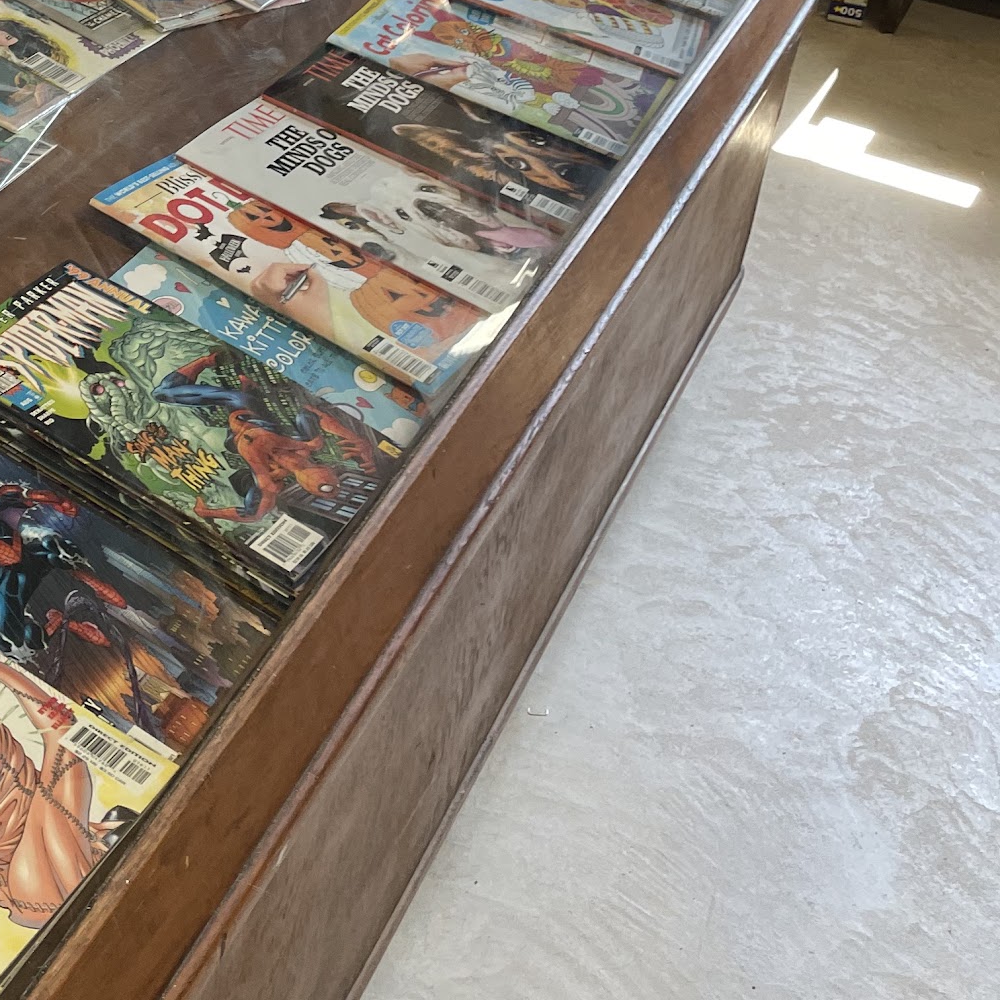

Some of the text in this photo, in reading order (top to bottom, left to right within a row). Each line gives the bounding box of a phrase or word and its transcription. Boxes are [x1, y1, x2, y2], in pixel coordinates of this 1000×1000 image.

[302, 49, 357, 83] TIME
[341, 65, 382, 92] THE
[346, 75, 399, 114] MINDS
[378, 80, 425, 114] DOGS
[220, 103, 287, 140] TIME
[264, 124, 310, 151] THE
[266, 136, 327, 177] MINDS
[316, 128, 338, 141] O
[302, 141, 355, 176] DOGS
[138, 186, 230, 244] DOT
[12, 275, 60, 311] PARKER
[89, 278, 153, 315] ANNUAL
[217, 303, 262, 341] KAWA
[265, 329, 315, 373] COLOR
[169, 447, 225, 494] THING
[88, 723, 157, 768] DIRECT EDITION
